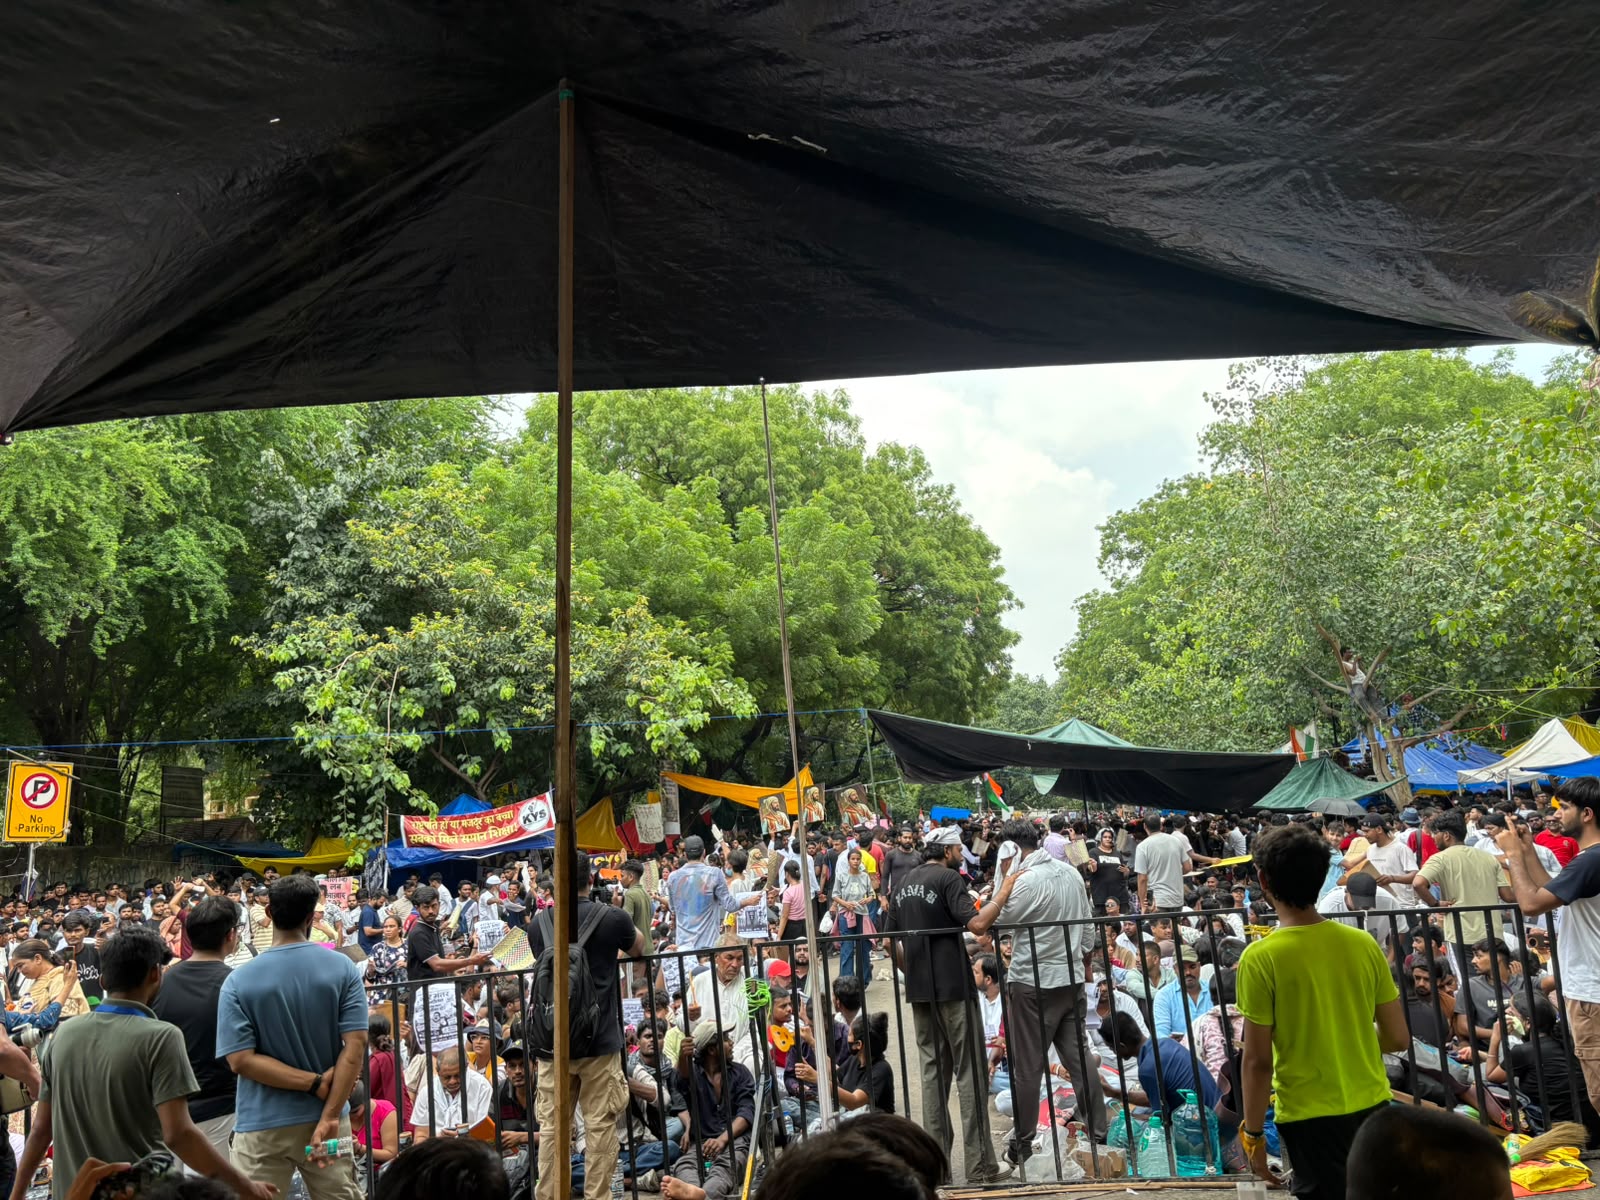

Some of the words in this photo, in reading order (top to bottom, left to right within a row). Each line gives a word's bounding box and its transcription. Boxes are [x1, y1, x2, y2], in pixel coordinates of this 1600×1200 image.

[29, 814, 43, 823] No
[522, 808, 547, 825] KYS
[18, 823, 56, 835] Parking
[438, 831, 458, 844] मिले
[460, 833, 487, 843] समान
